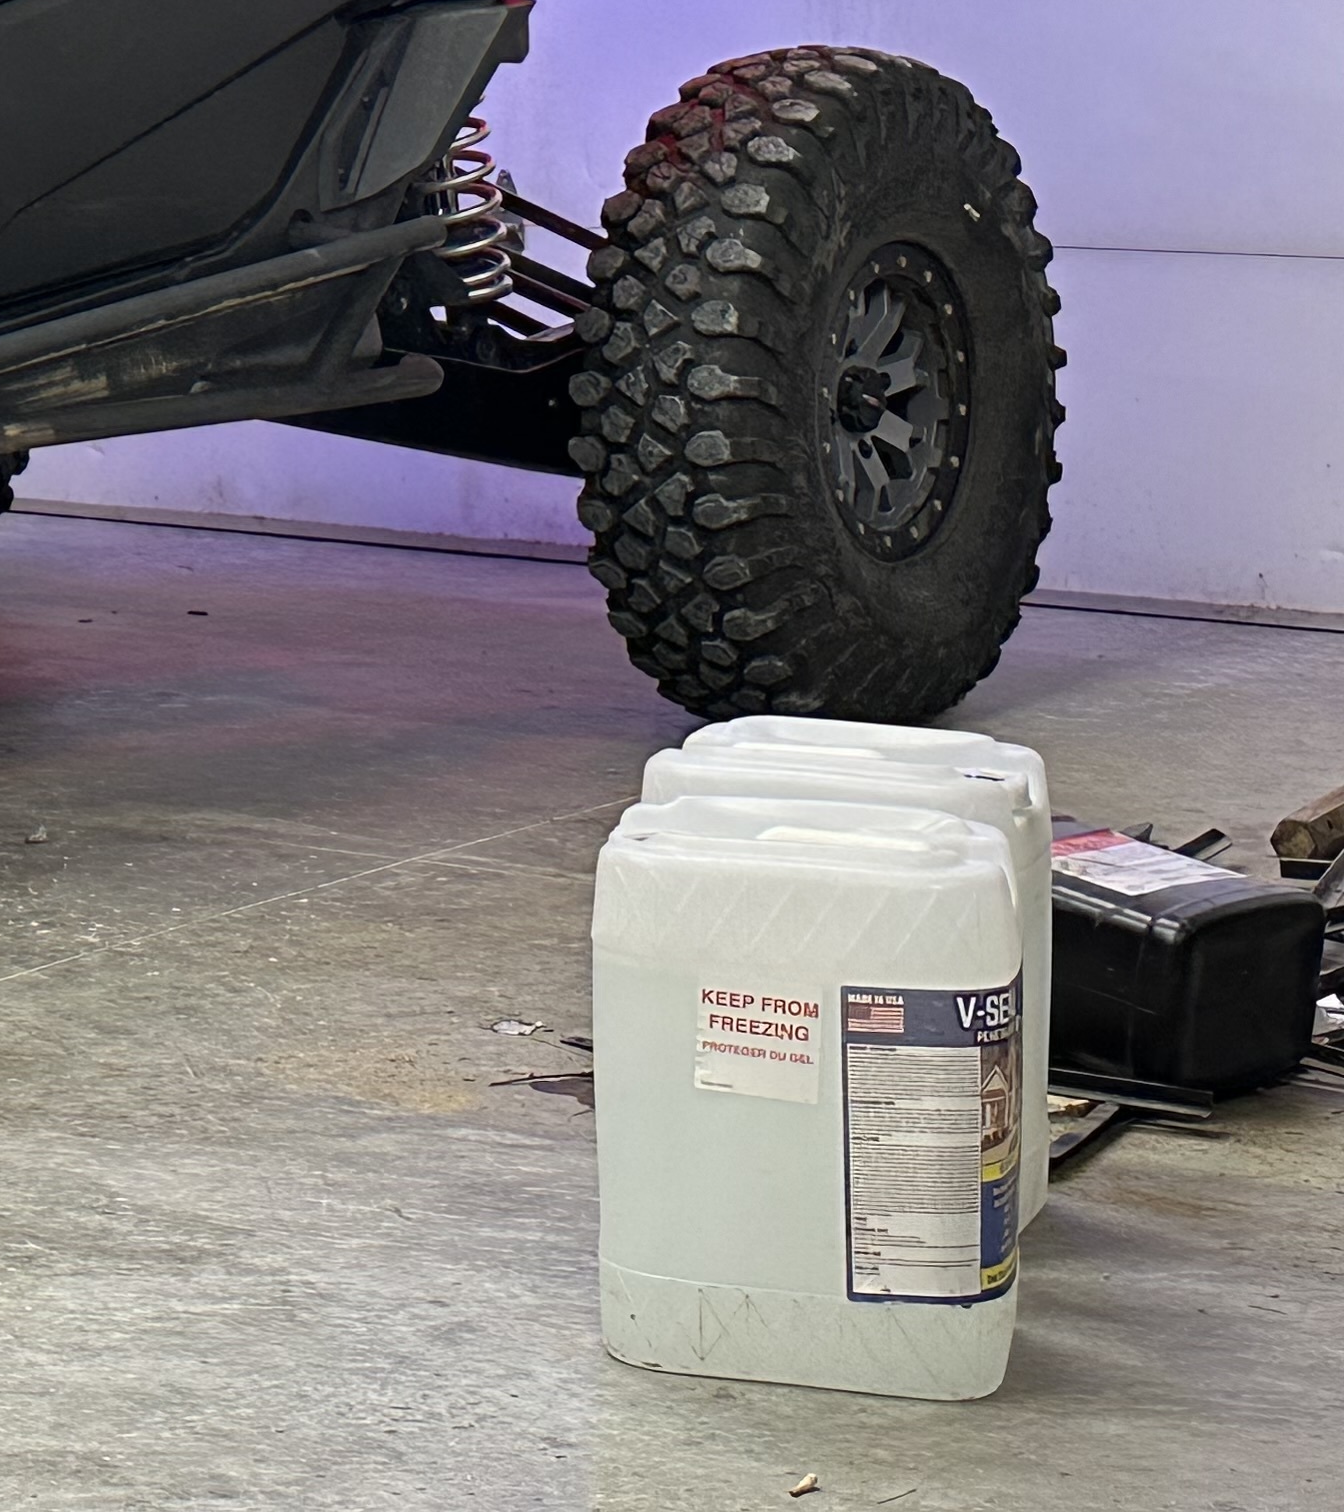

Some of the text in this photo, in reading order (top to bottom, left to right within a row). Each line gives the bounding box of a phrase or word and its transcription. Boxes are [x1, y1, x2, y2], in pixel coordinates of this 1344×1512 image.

[702, 988, 819, 1019] KEEP FROM
[848, 994, 905, 1005] MADE IN USA
[709, 1013, 810, 1041] FREEZING
[769, 1050, 787, 1061] DU
[790, 1053, 815, 1065] GEL
